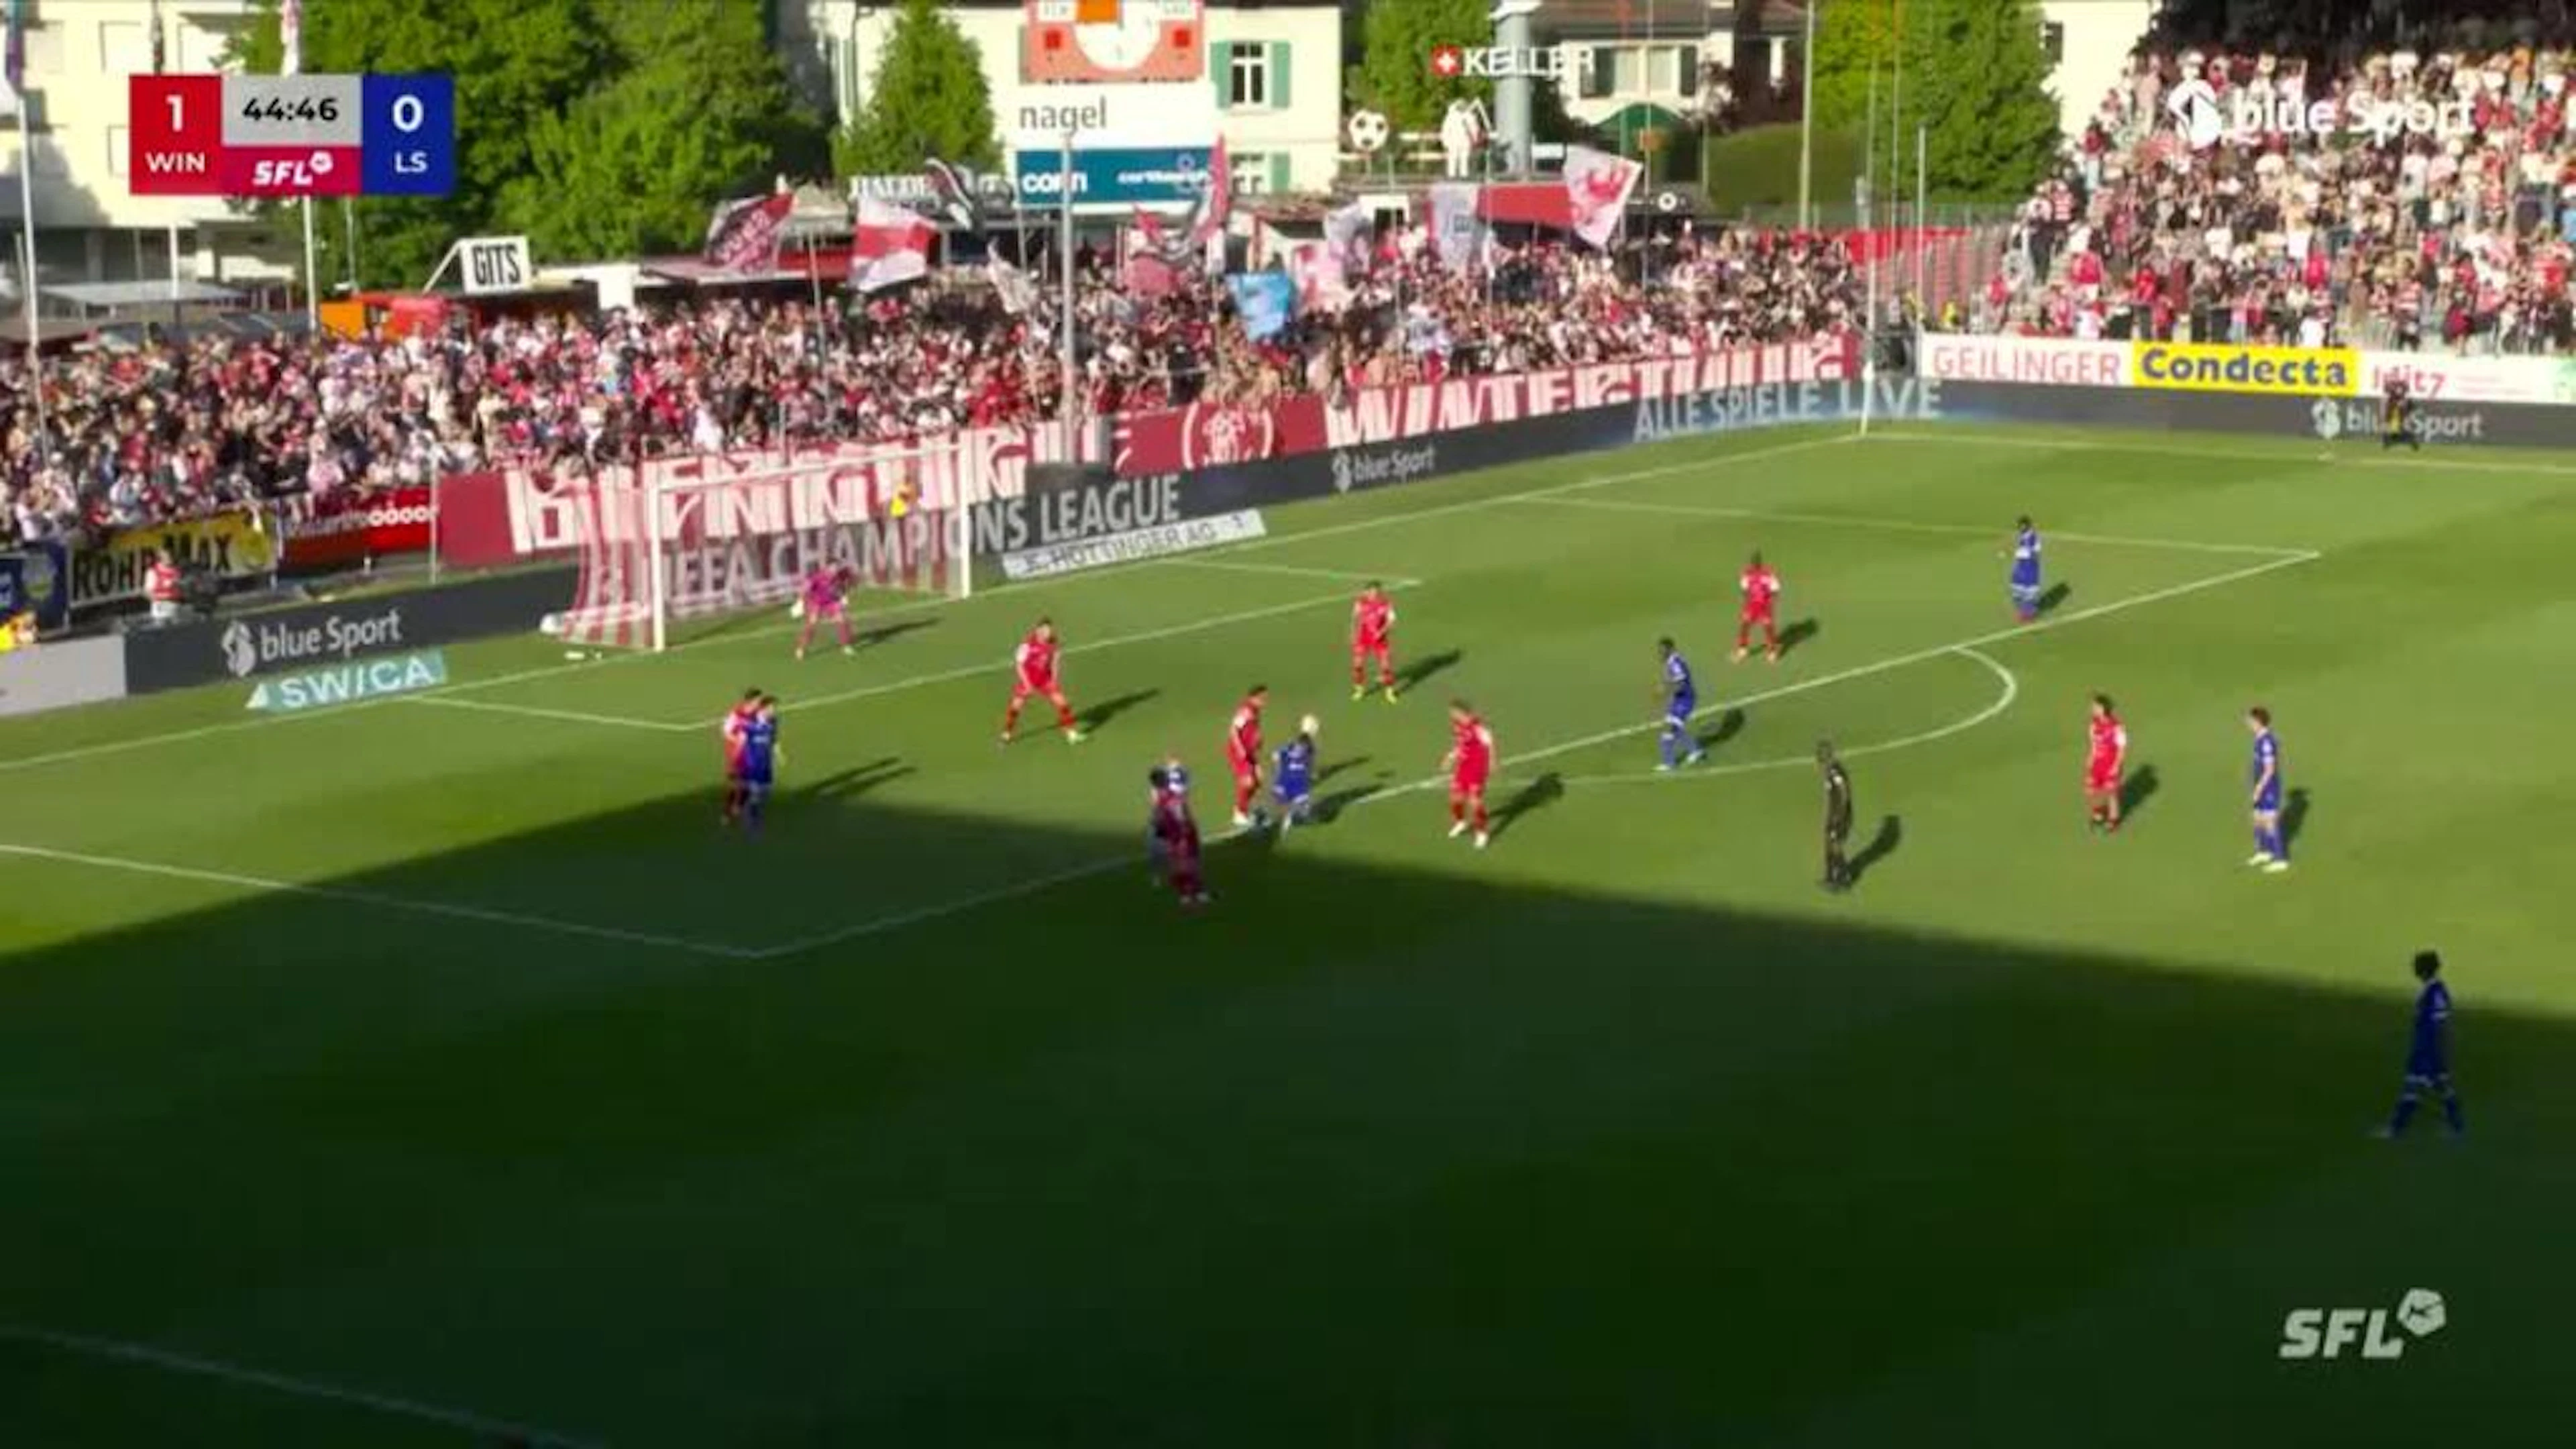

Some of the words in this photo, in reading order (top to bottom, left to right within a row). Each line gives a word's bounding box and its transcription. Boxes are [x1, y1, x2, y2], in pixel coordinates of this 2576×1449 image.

[1464, 46, 1595, 76] KELLER
[1018, 95, 1106, 133] nagel
[472, 244, 521, 286] GITS
[1933, 346, 2121, 384] GEILINGER
[2141, 348, 2348, 388] Condecta
[1633, 393, 1702, 443] ALLE
[1709, 380, 1822, 431] SPIELE
[1839, 377, 1943, 419] LVE
[2408, 408, 2483, 441] Sport
[1354, 453, 1389, 482] blue
[1391, 443, 1436, 484] Sport
[1040, 474, 1181, 543] LEAGUE
[260, 623, 322, 663] blue
[326, 607, 403, 658] Sport
[278, 655, 434, 709] SWICA
